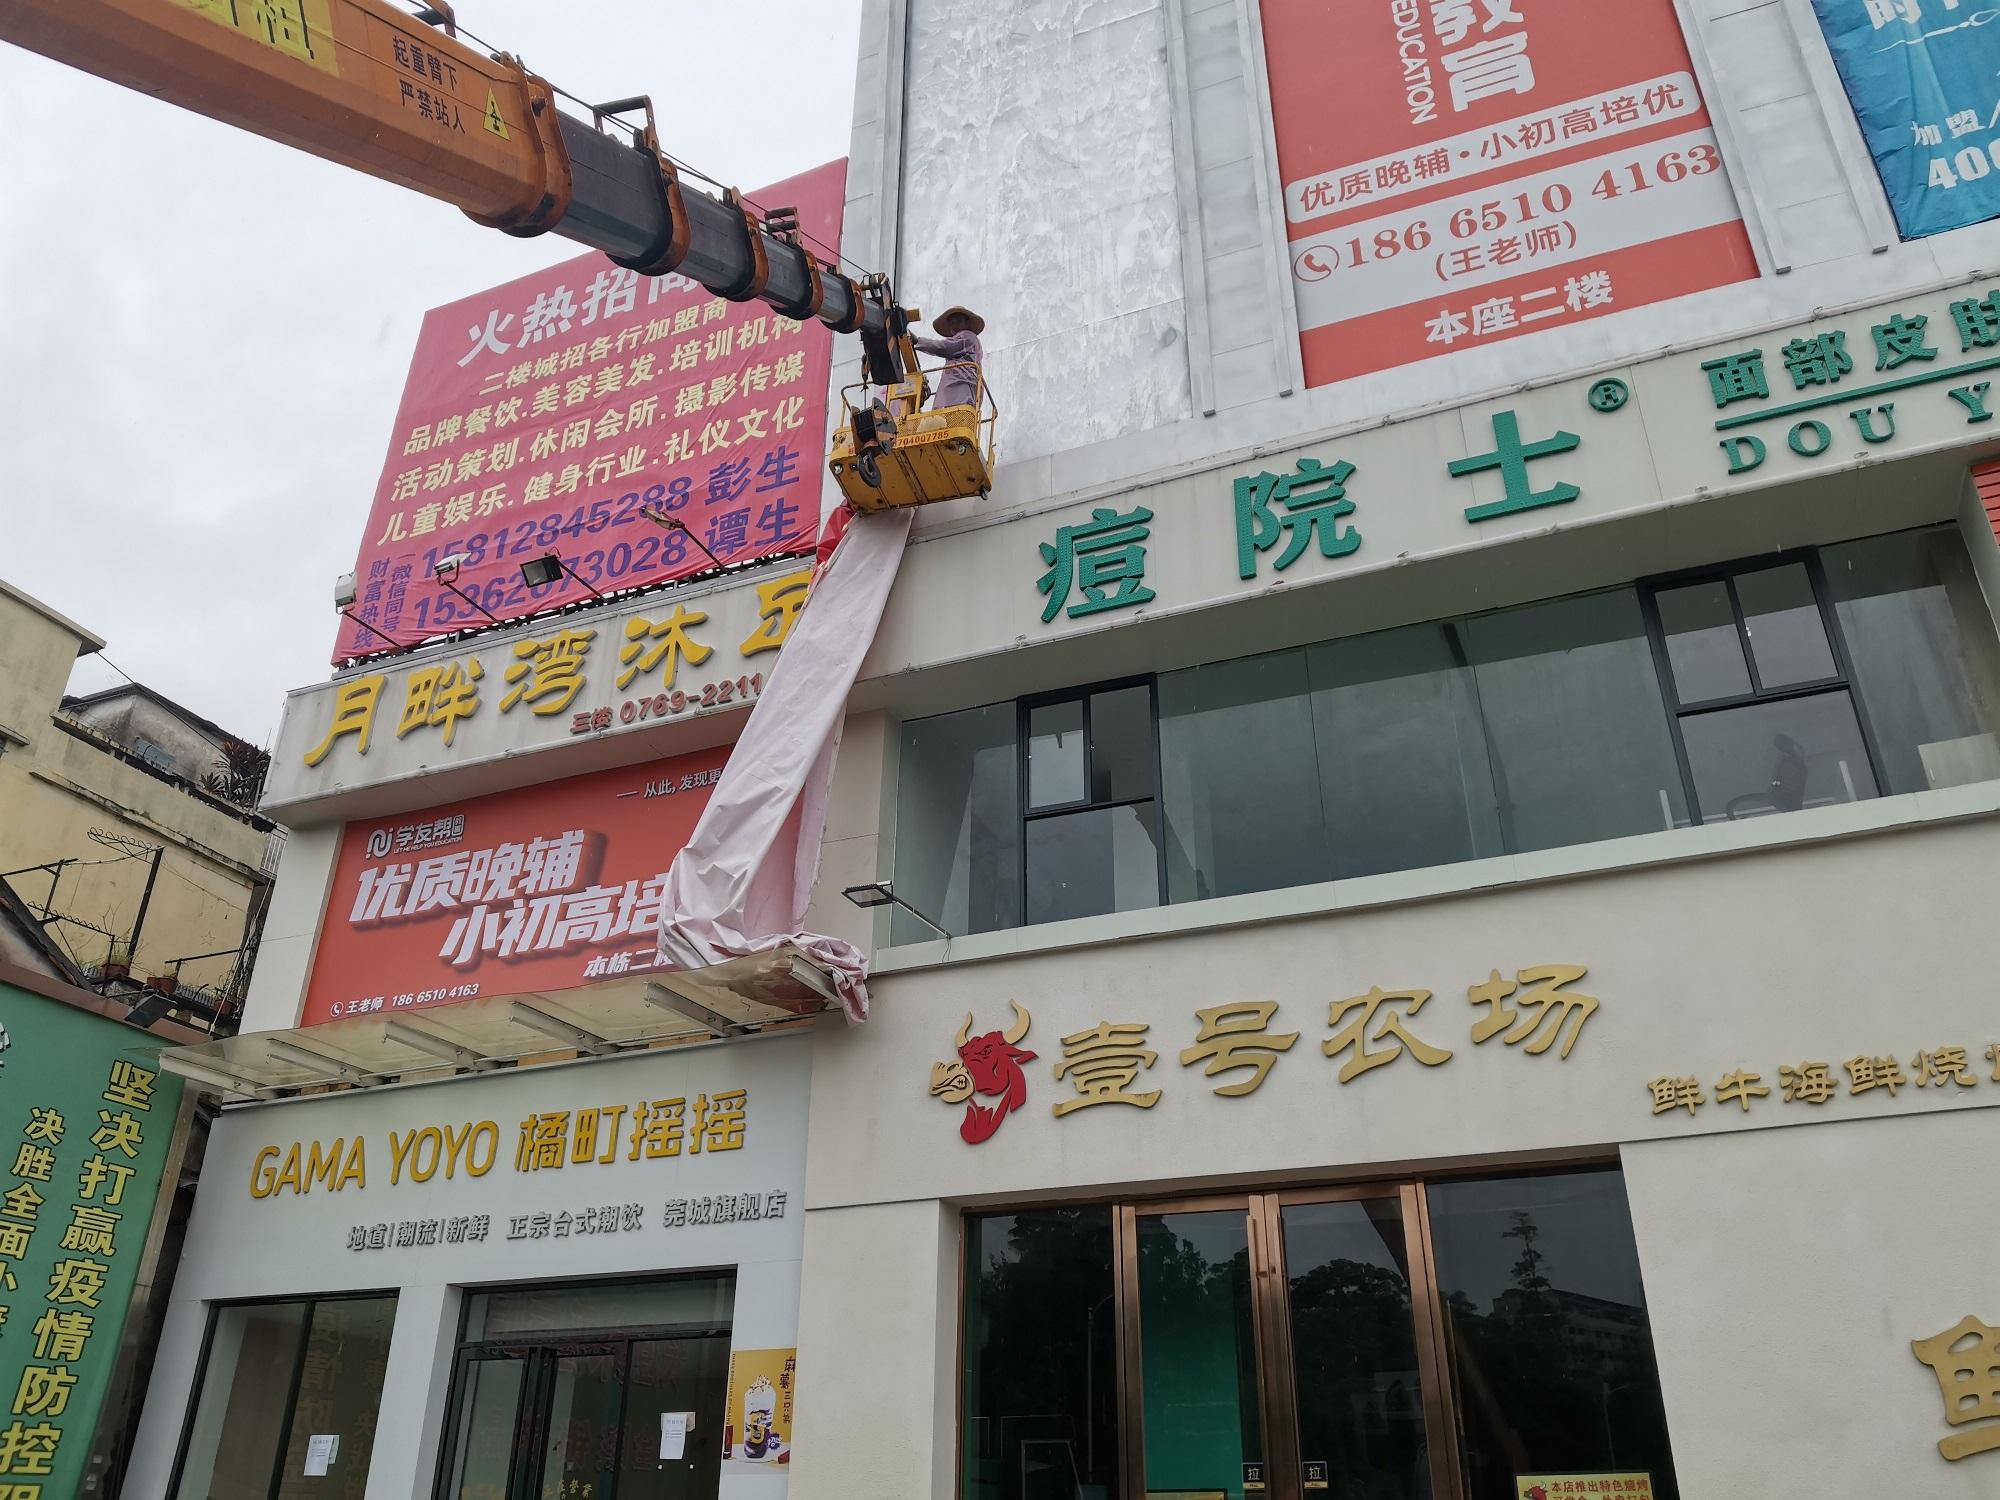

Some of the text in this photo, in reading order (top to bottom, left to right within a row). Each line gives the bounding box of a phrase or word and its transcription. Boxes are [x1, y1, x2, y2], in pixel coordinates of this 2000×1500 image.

[392, 35, 457, 92] 起重臂下
[399, 79, 466, 135] 严禁站人
[1300, 82, 1685, 213] 优质晚辅·小初高培优
[1345, 143, 1721, 269] 186 6510 4163
[1434, 220, 1578, 281] (王老师)
[1424, 270, 1614, 345] 本座二楼
[479, 297, 728, 396] 二楼城招各行加盟商
[703, 445, 801, 507] 彭生
[413, 497, 801, 630] 1536273028 谭生
[352, 557, 391, 650] 财富热线
[570, 706, 613, 735] 三楼
[396, 816, 453, 847] 学友帮
[349, 828, 587, 924] 优质晚辅
[346, 983, 479, 1014] 王老师 186 6510 4163
[1052, 963, 1600, 1119] 壹号农场
[249, 1089, 748, 1200] GAMA YOYO 橘町摇摇
[506, 1203, 643, 1241] 正宗台式潮饮
[663, 1190, 788, 1228] 莞城旗舰店
[0, 1059, 157, 1500] 坚决打赢疫情防控
[1248, 1467, 1260, 1481] 拉
[1309, 1466, 1322, 1480] 拉
